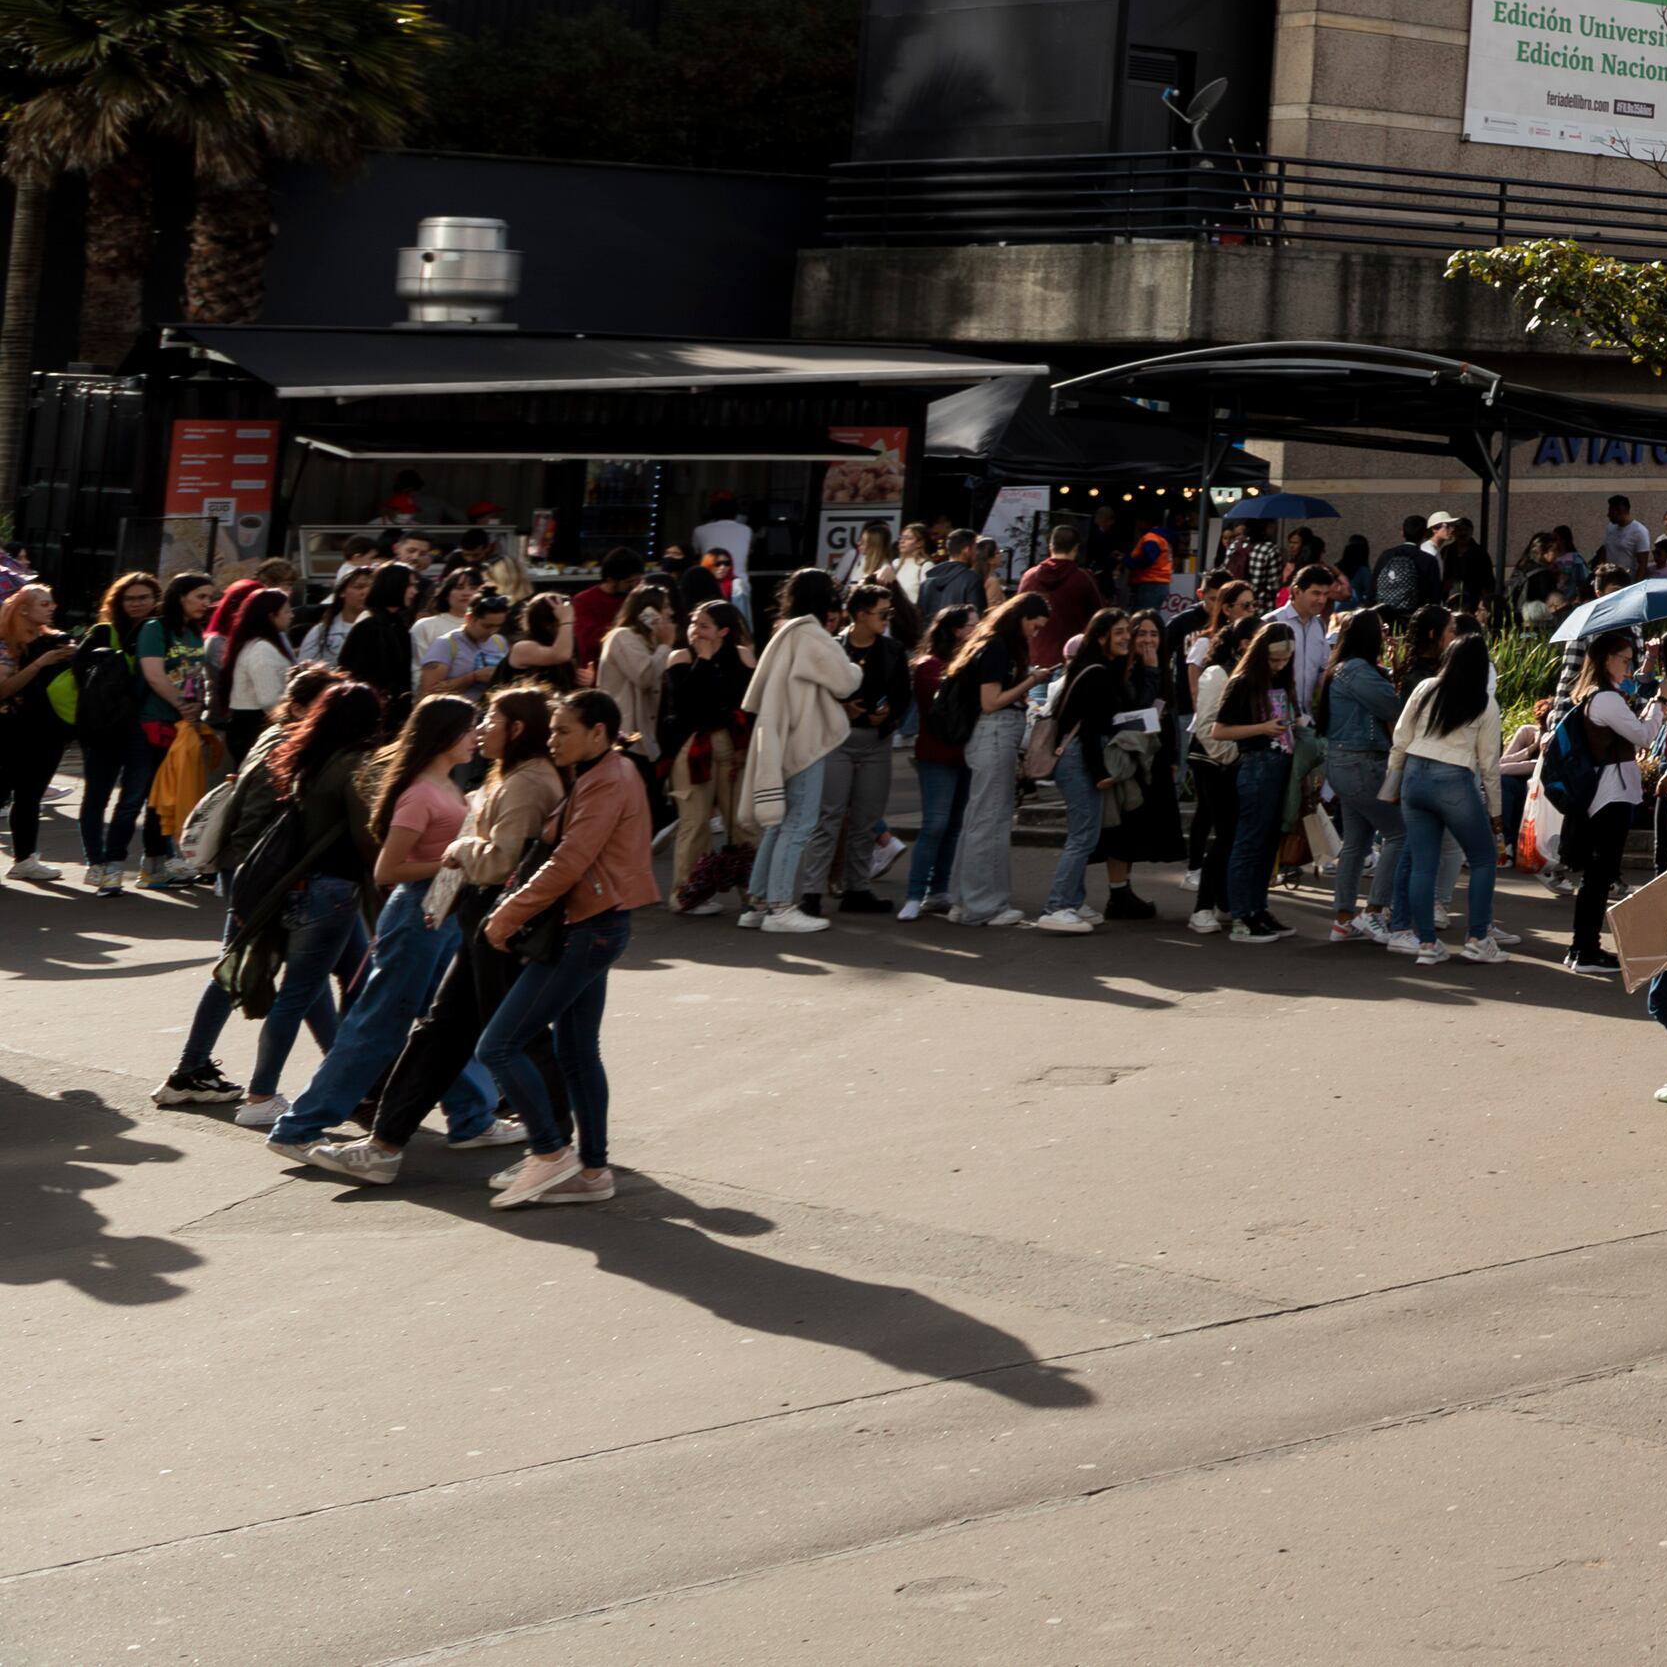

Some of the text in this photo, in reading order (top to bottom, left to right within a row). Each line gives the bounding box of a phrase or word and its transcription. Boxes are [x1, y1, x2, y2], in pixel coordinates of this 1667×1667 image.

[1493, 0, 1572, 33] Edición
[1516, 40, 1595, 72] Edición
[1546, 90, 1610, 113] feriadellibro.com
